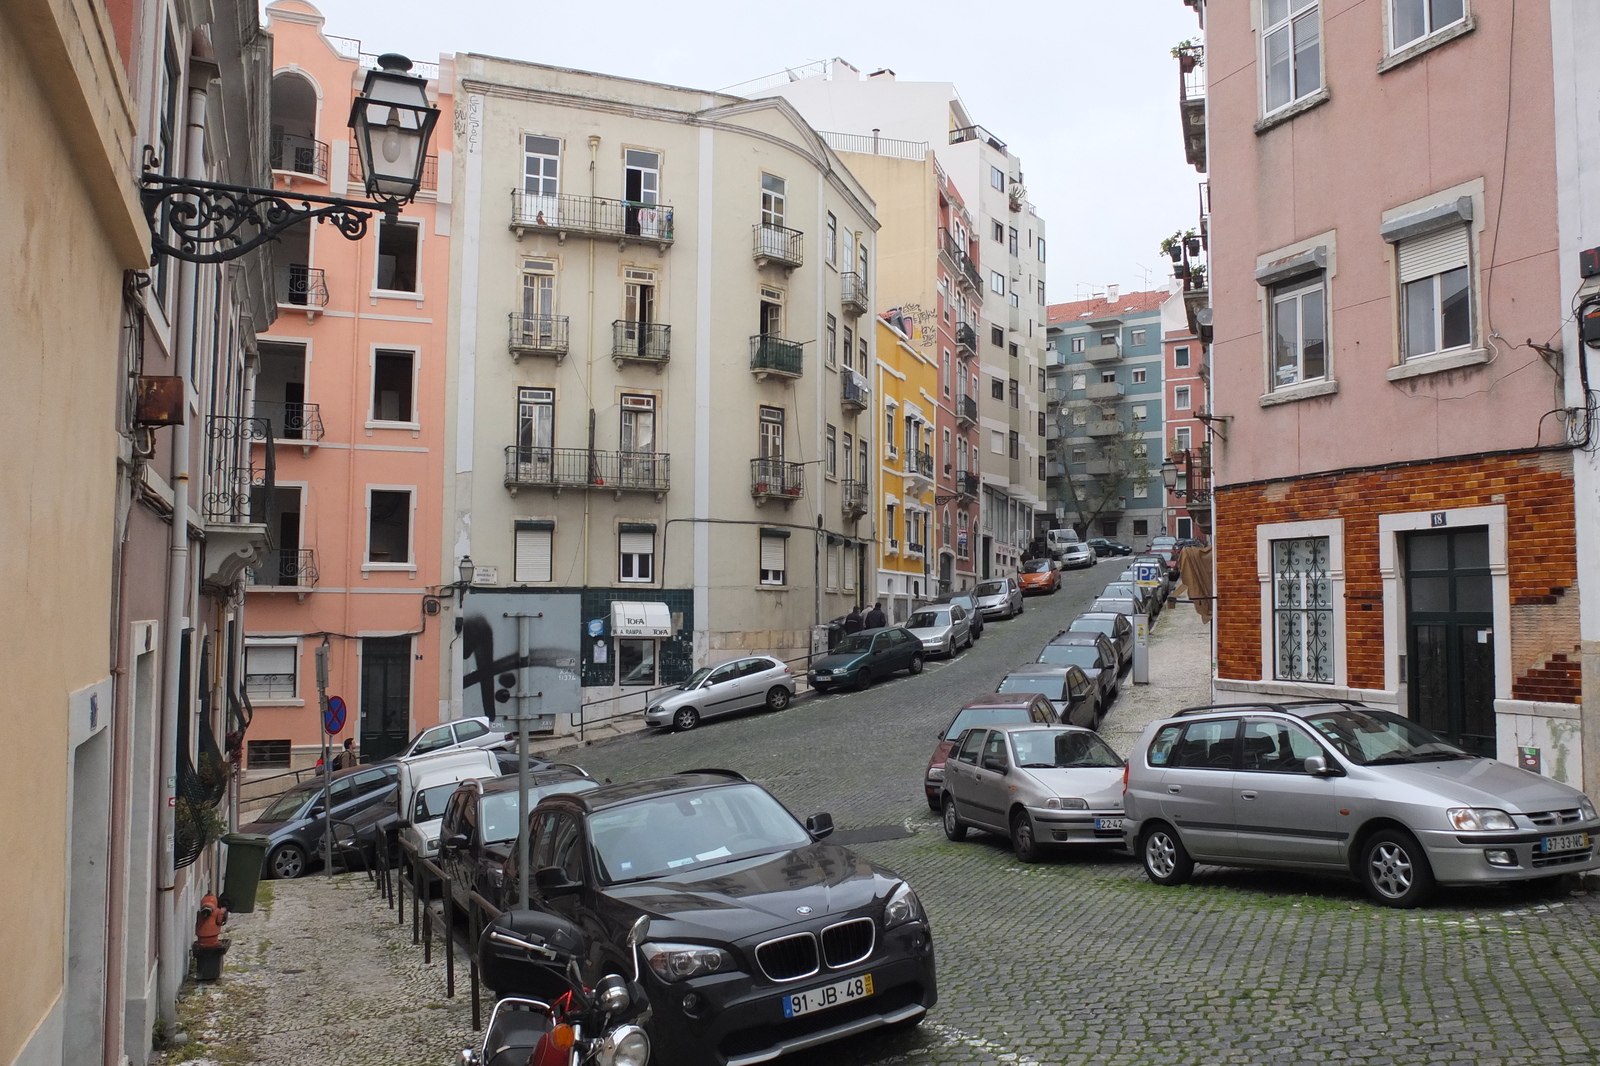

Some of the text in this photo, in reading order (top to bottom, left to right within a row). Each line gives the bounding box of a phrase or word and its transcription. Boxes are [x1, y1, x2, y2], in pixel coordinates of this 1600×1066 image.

[1433, 513, 1443, 525] 18
[1140, 567, 1149, 581] P
[626, 617, 645, 625] TOFA
[652, 628, 668, 636] TOFA
